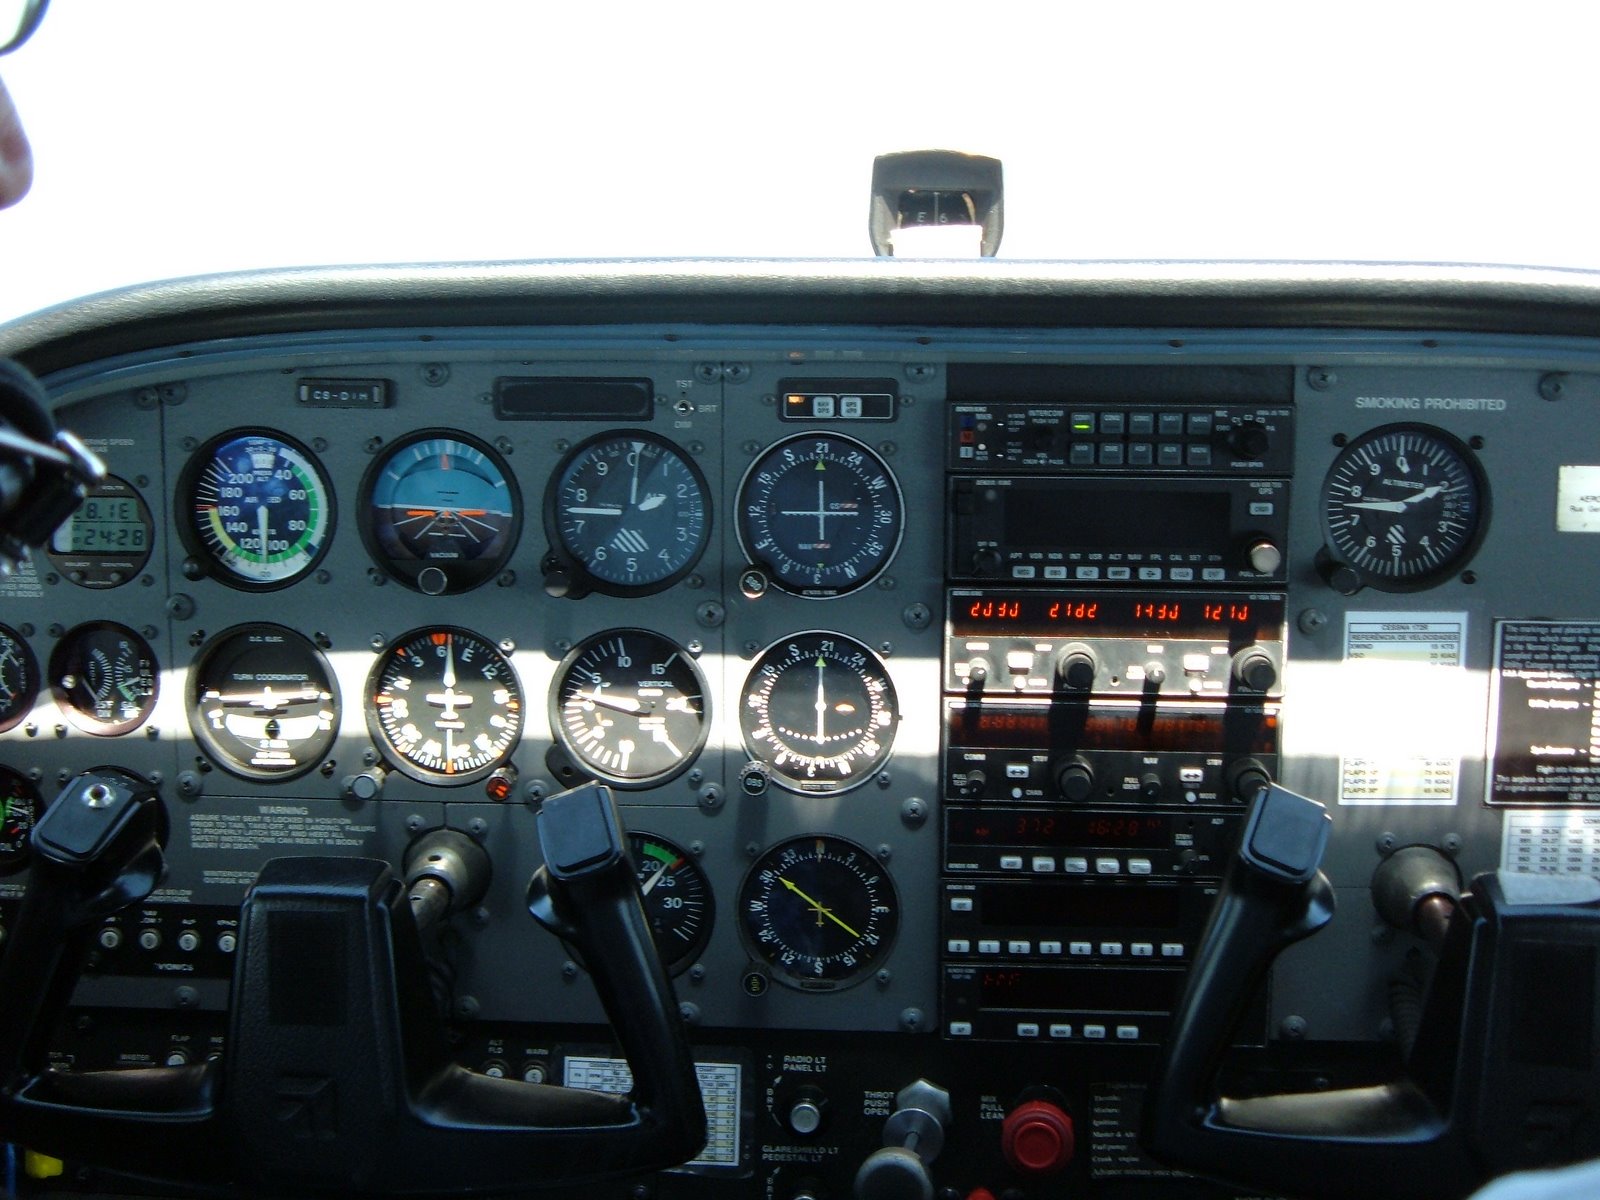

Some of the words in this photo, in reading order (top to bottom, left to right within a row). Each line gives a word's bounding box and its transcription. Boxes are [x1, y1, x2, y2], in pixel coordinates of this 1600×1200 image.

[1354, 397, 1421, 410] SMOKING
[1424, 398, 1507, 411] PROHIBITED
[816, 443, 829, 454] 21
[783, 449, 795, 462] S
[848, 452, 863, 465] 24
[596, 462, 608, 475] 9
[664, 464, 668, 476] 1
[1370, 464, 1381, 475] 9
[1423, 464, 1427, 475] 1
[229, 473, 254, 484] 200
[275, 470, 292, 480] 40
[757, 471, 772, 485] 15
[872, 475, 888, 490] W
[1440, 481, 1449, 492] 2
[221, 487, 243, 498] 180
[289, 490, 306, 500] 60
[576, 488, 588, 502] 8
[677, 484, 687, 498] 2
[1351, 486, 1362, 497] 8
[218, 506, 240, 516] 160
[748, 505, 761, 517] 12
[880, 510, 893, 525] 30
[1350, 515, 1360, 526] 7
[226, 522, 248, 532] 140
[288, 520, 306, 531] 80
[574, 520, 586, 534] 7
[1437, 521, 1448, 533] 3
[677, 527, 687, 541] 3
[240, 538, 261, 549] 120
[267, 540, 289, 551] 100
[755, 540, 769, 551] E
[1365, 536, 1377, 547] 6
[1419, 536, 1430, 546] 4
[595, 547, 607, 560] 6
[868, 541, 884, 557] 33
[1392, 545, 1402, 556] 5
[658, 549, 670, 561] 4
[626, 558, 637, 571] 5
[780, 564, 790, 575] 6
[844, 565, 858, 578] N
[813, 573, 822, 584] 3
[436, 646, 447, 657] 6
[789, 644, 800, 657] S
[820, 641, 834, 651] 21
[461, 648, 474, 663] E
[851, 653, 867, 666] 24
[411, 656, 424, 667] 3
[617, 657, 631, 667] 10
[481, 664, 498, 680] 12
[651, 664, 665, 674] 15
[761, 664, 775, 677] 15
[394, 676, 411, 690] N
[592, 673, 601, 683] 5
[746, 778, 763, 787] OBS
[259, 806, 308, 815] WARNING
[782, 849, 797, 862] 33
[848, 852, 855, 861] 3
[642, 860, 660, 872] 20
[657, 876, 676, 887] 25
[759, 869, 774, 884] 30
[663, 897, 682, 909] 30
[750, 900, 764, 911] W
[758, 930, 773, 942] 24
[865, 934, 880, 946] 12
[781, 952, 796, 965] 21
[843, 954, 857, 966] 15
[814, 962, 824, 974] S
[784, 1056, 812, 1064] RADIO
[815, 1056, 826, 1064] LT
[783, 1064, 813, 1072] PANEL
[864, 1091, 894, 1099] THROT
[864, 1108, 890, 1116] OPEN
[762, 1145, 826, 1154] GLARESHIELD
[762, 1154, 809, 1162] PEDESTAL
